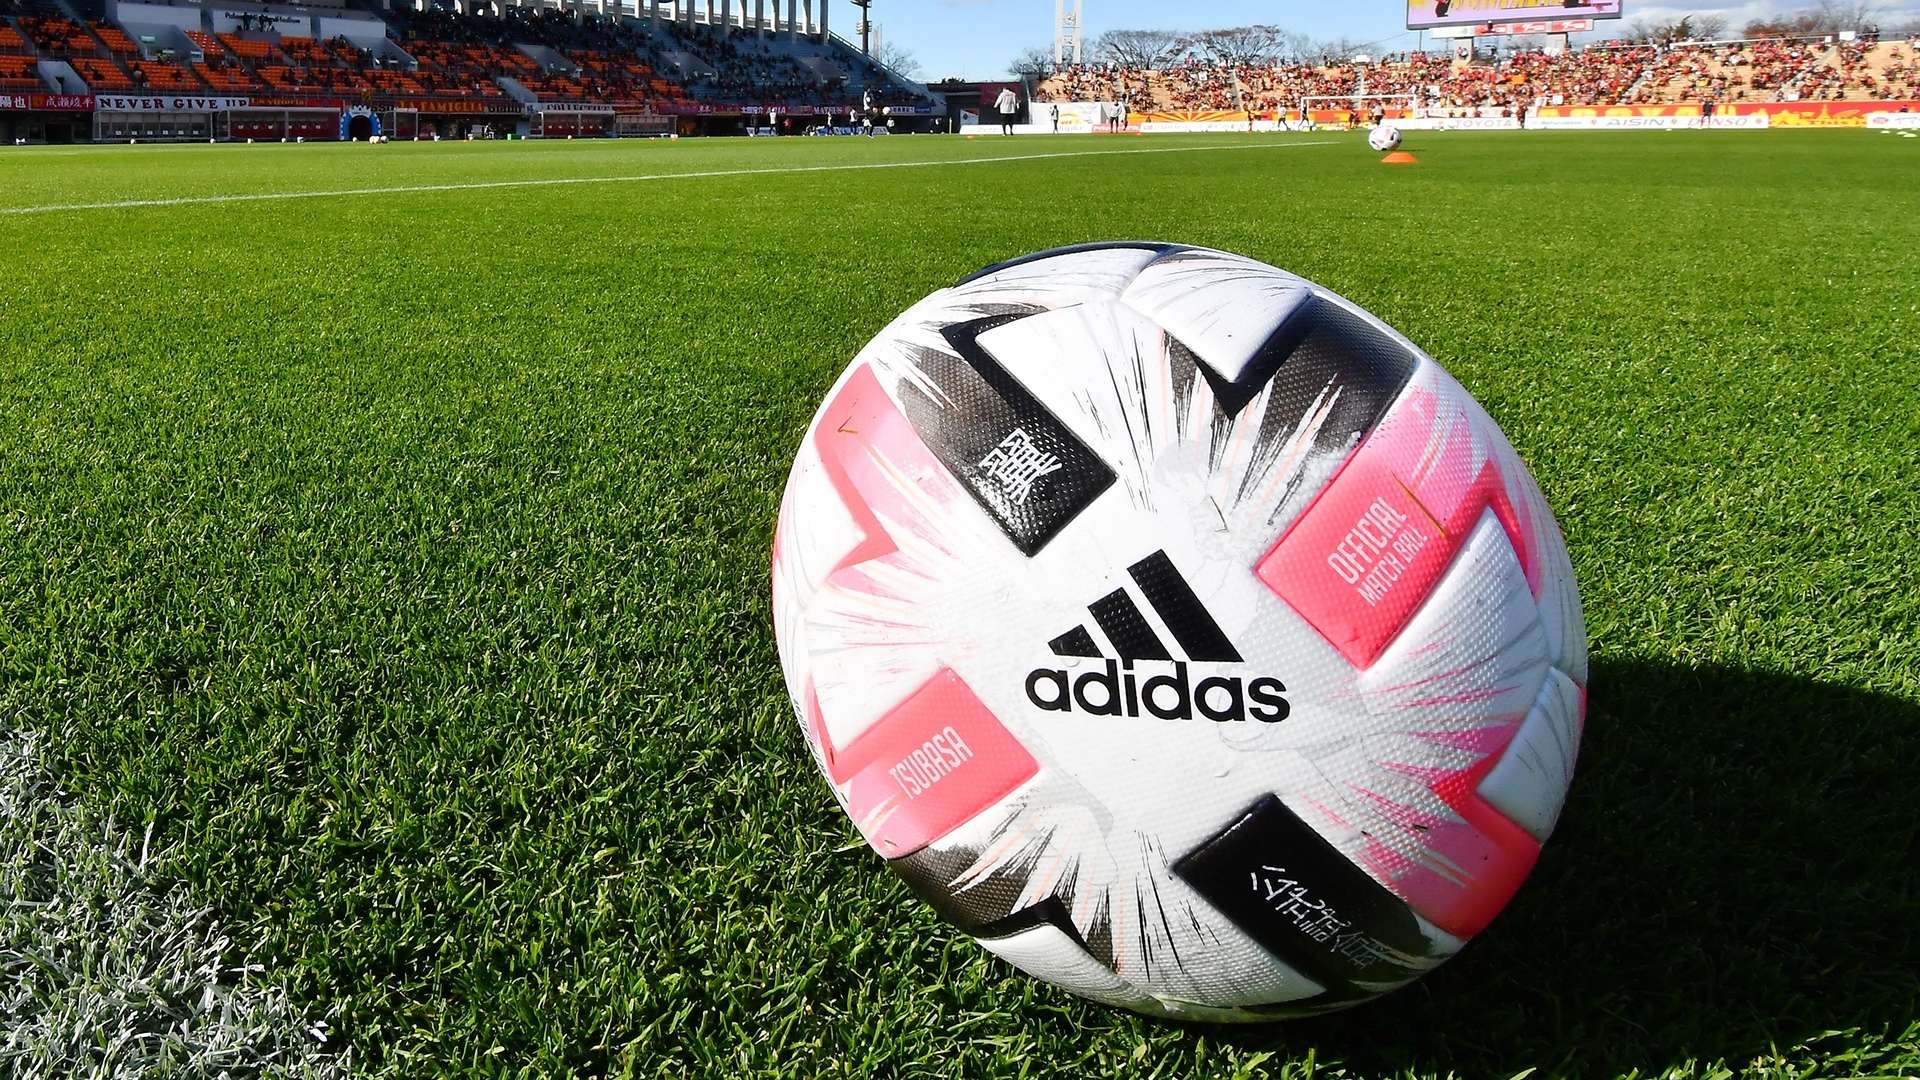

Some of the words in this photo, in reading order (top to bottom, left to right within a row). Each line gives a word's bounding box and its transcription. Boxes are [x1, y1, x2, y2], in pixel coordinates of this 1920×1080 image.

[99, 98, 164, 109] NEVER
[173, 98, 218, 109] GIVE
[225, 98, 248, 107] UP
[421, 101, 483, 111] FAMIGLIA
[1606, 118, 1665, 127] AISIN
[1456, 119, 1512, 128] TOYOTA
[1327, 496, 1407, 585] OFFICIAL
[1357, 551, 1406, 607] MATCH
[1392, 524, 1428, 564] BALL
[1025, 657, 1291, 723] adidas
[889, 726, 974, 800] TSUBASA
